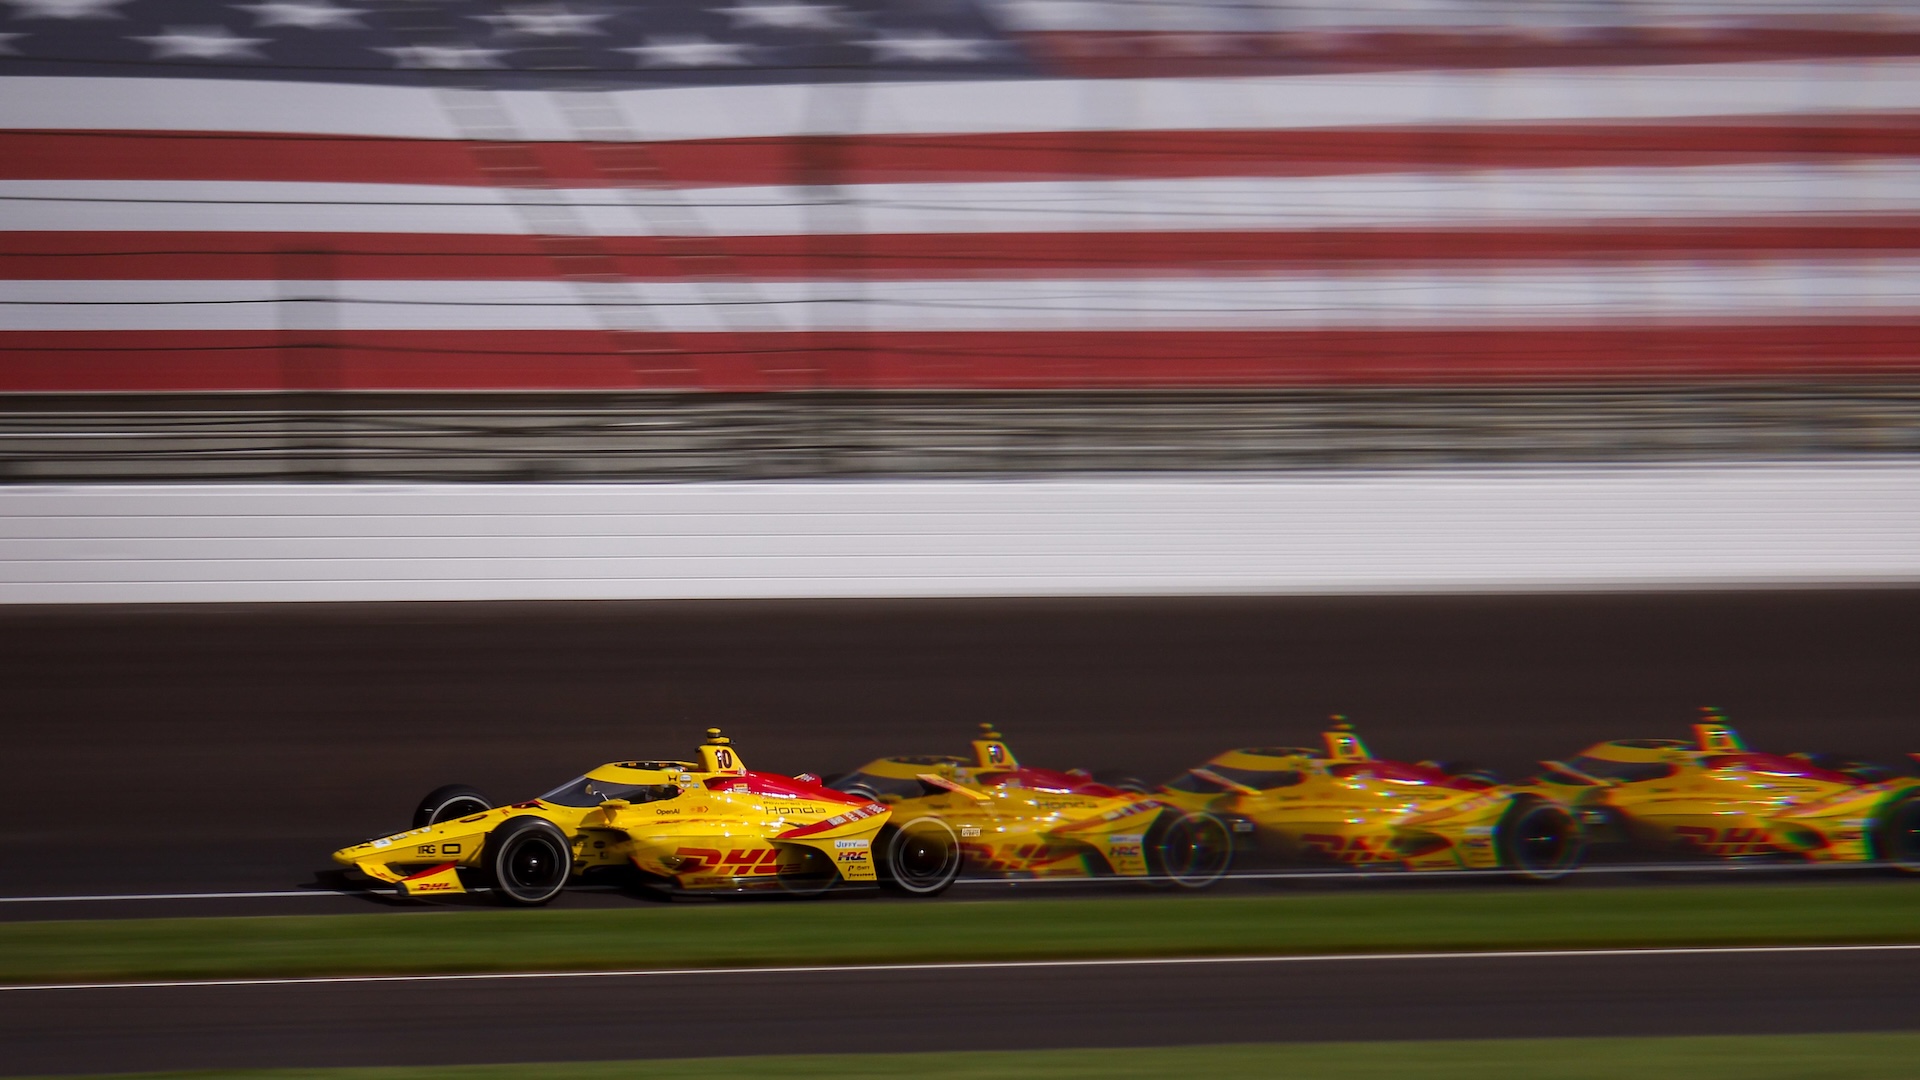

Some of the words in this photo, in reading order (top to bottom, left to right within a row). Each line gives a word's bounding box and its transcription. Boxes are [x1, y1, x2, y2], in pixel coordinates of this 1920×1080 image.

[715, 750, 732, 769] 10
[765, 806, 826, 815] Honda
[673, 847, 783, 875] DHL
[838, 851, 868, 861] HRC
[418, 883, 452, 891] DHL
